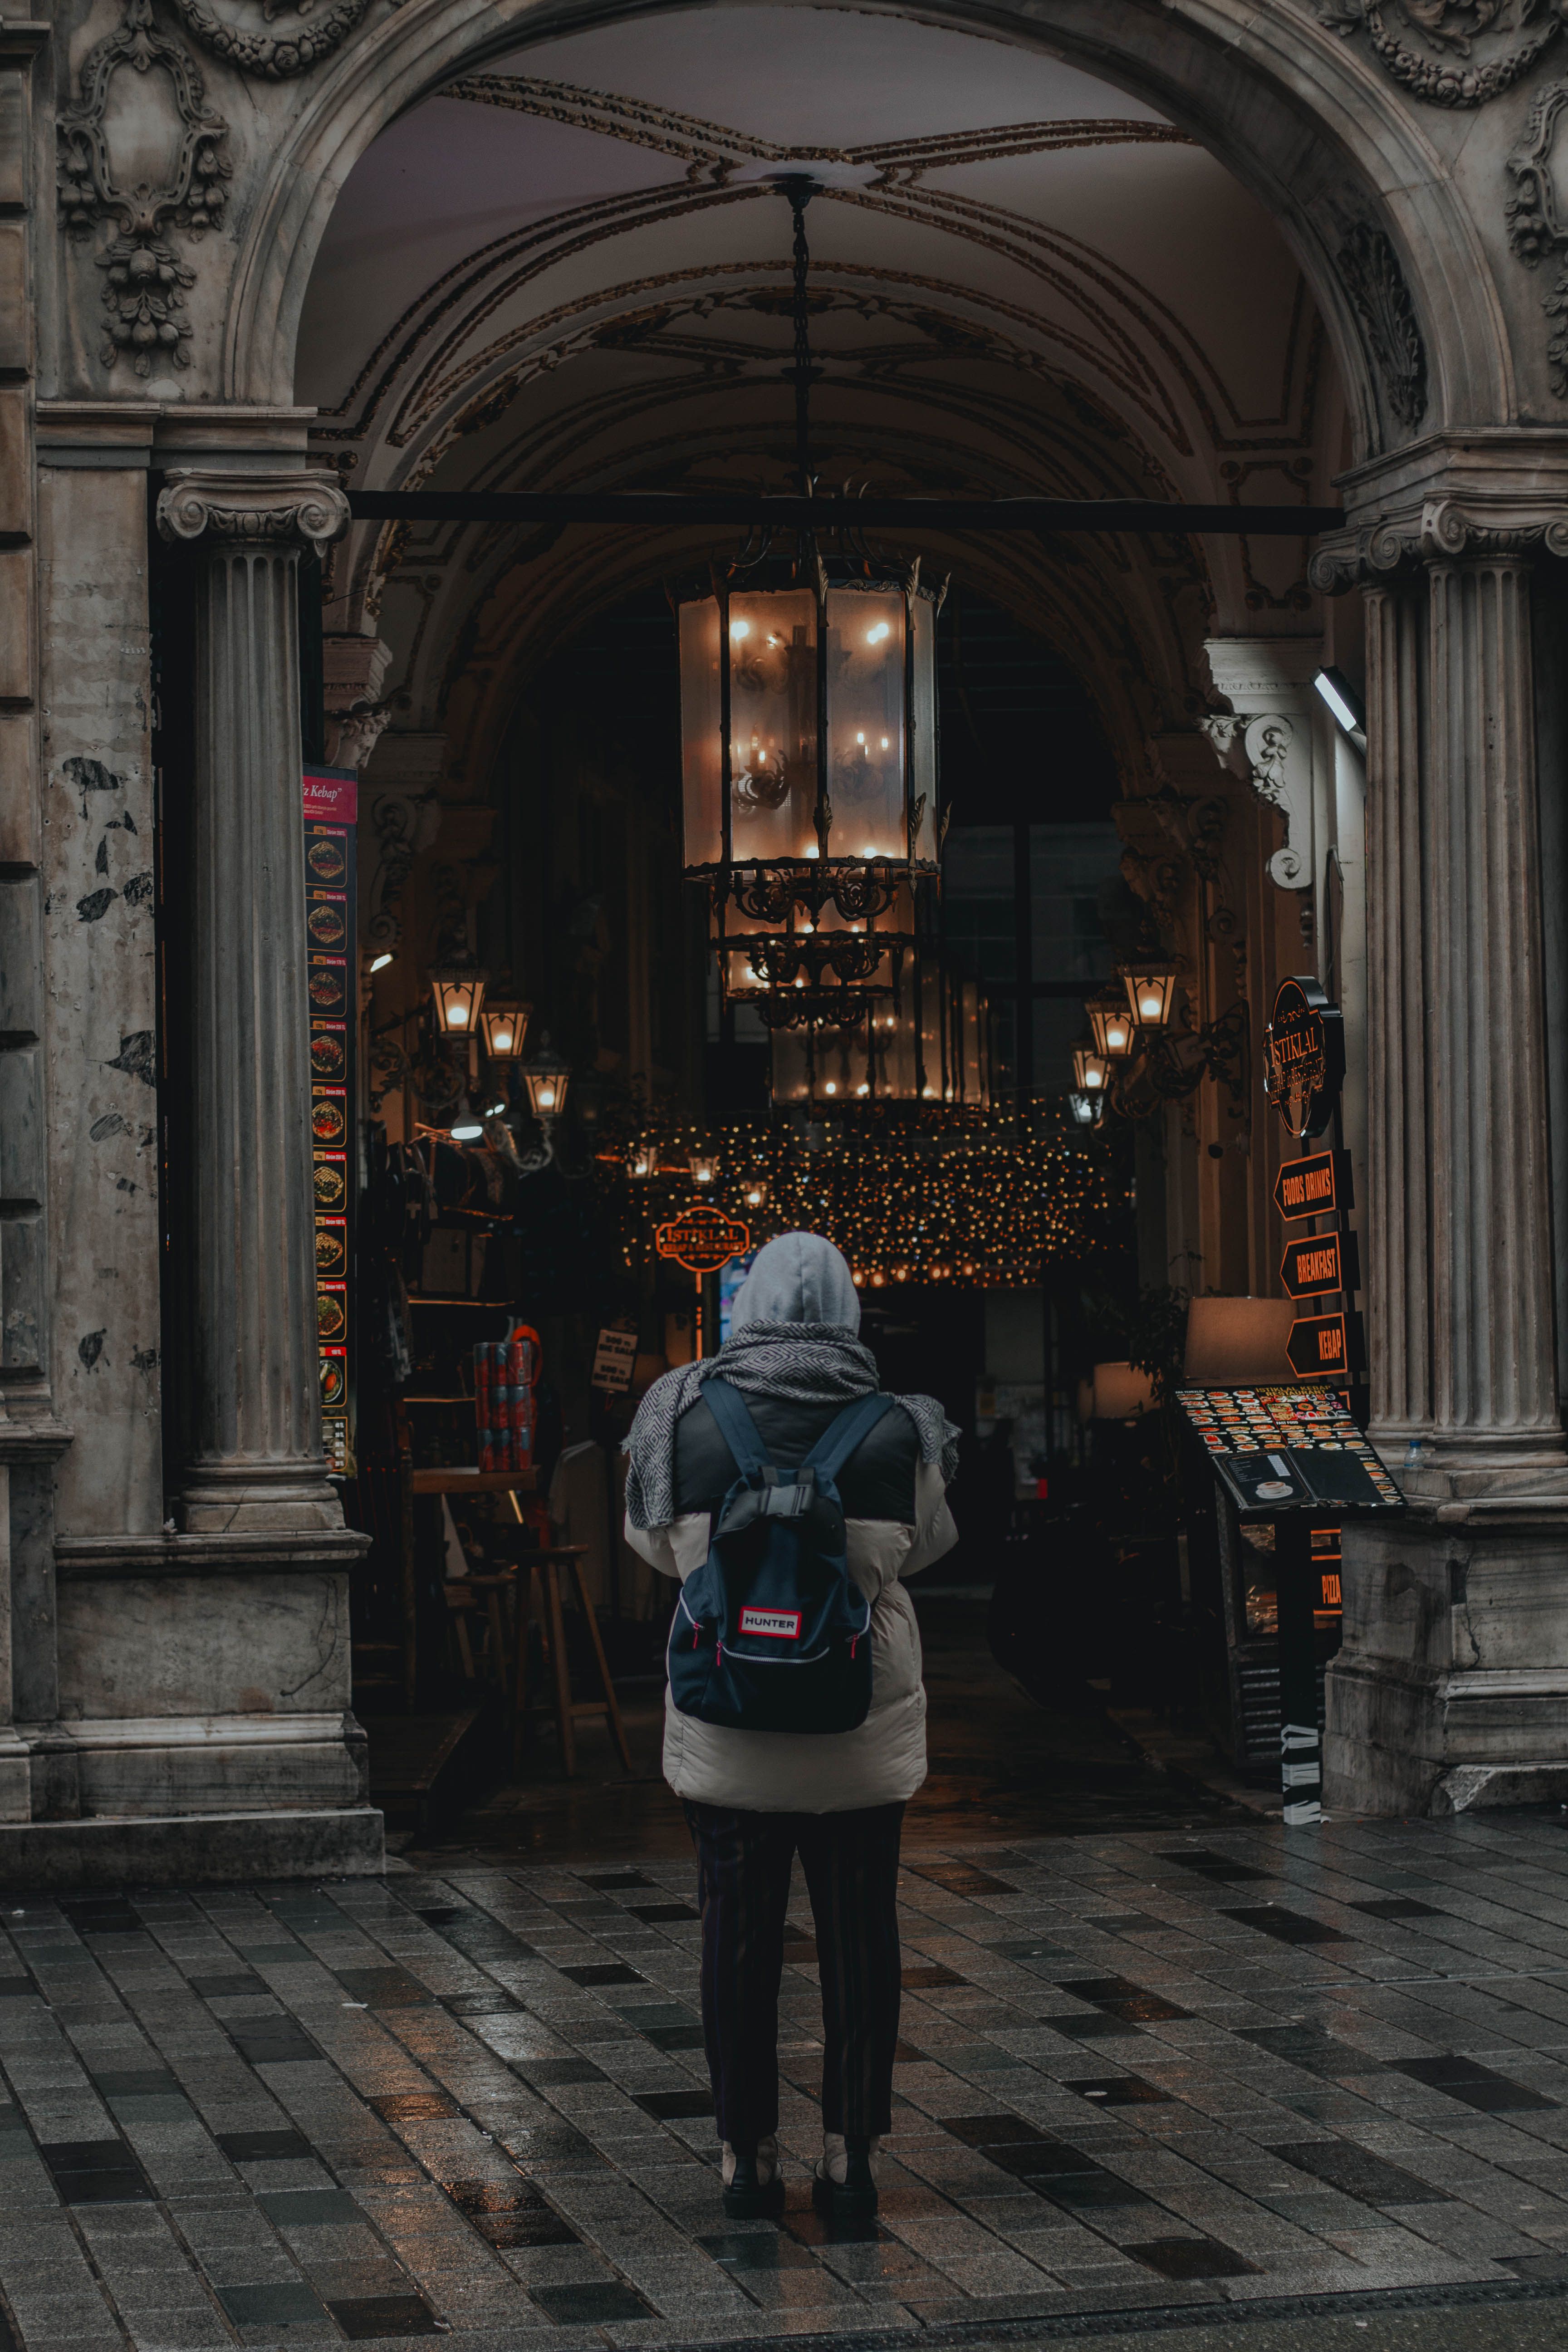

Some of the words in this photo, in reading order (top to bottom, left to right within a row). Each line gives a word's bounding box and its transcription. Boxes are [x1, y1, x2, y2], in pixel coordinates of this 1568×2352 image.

[1282, 1174, 1305, 1207] FOODS
[1305, 1167, 1332, 1201] DRINKS
[1296, 1248, 1336, 1284] BREAKFAST
[1318, 1328, 1342, 1361] KEBAP
[1322, 1573, 1342, 1605] PIZZA
[745, 1617, 795, 1629] HUNTER
